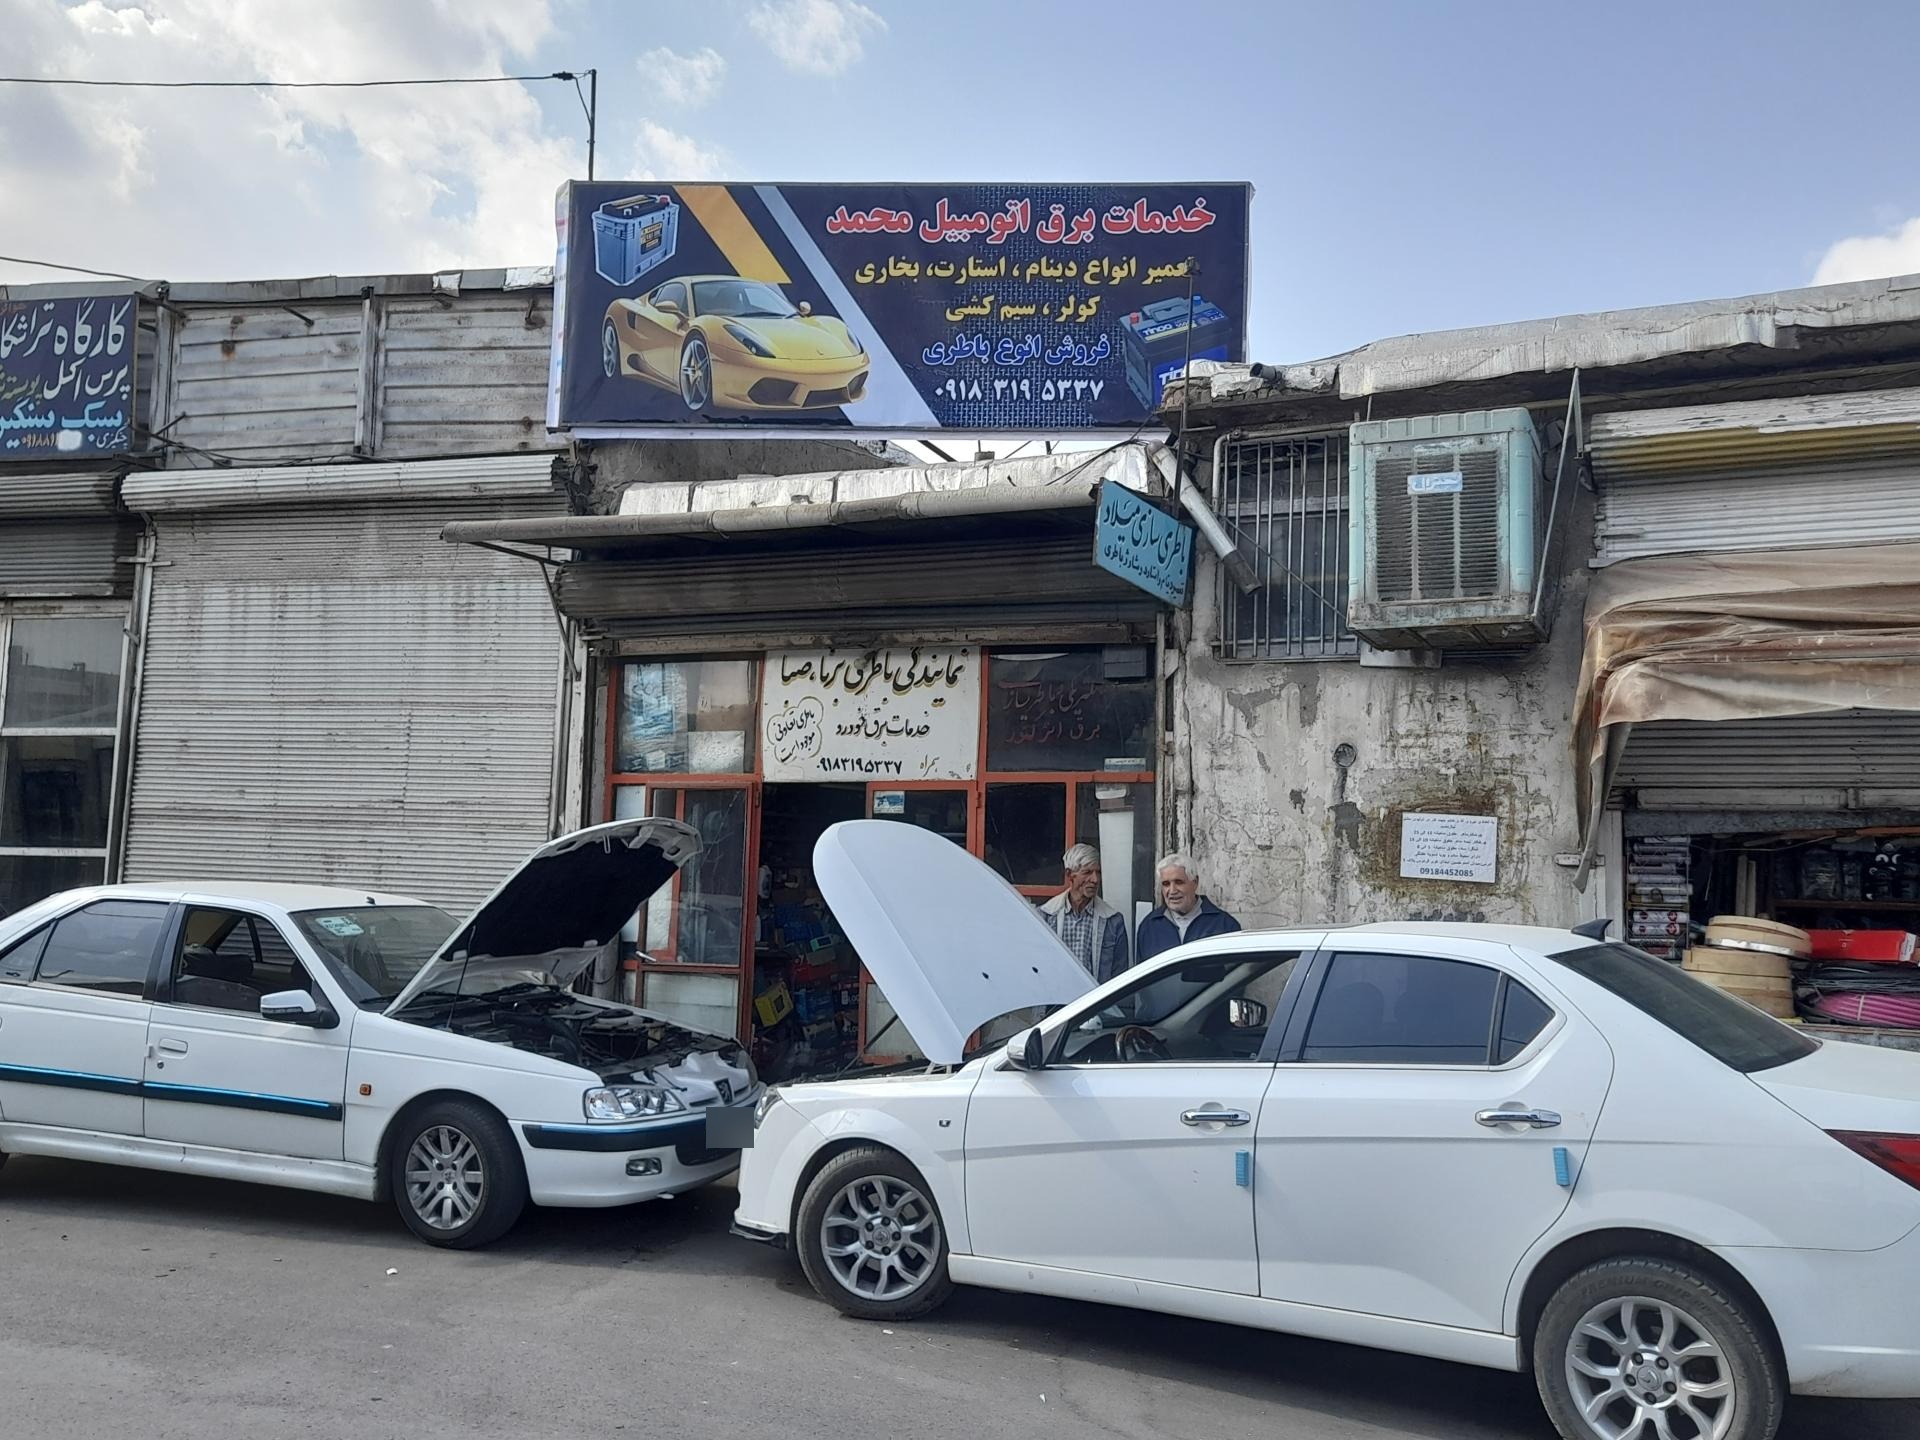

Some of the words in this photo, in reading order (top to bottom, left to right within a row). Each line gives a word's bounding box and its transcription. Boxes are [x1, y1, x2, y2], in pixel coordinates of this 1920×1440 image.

[826, 205, 914, 234] محمد
[918, 197, 1031, 244] اتومبیل
[1036, 203, 1096, 244] برق
[1102, 197, 1216, 234] خدمات
[855, 255, 920, 284] بخاری
[1025, 256, 1078, 284] دینام
[1084, 256, 1136, 285] انواع
[1141, 256, 1192, 285] عمیر
[945, 295, 995, 321] کشی
[1000, 302, 1036, 321] سیم
[1055, 295, 1101, 322] کولر
[0, 302, 55, 359] تراشکا
[54, 298, 131, 358] کارگاه
[922, 334, 991, 366] باطری
[993, 334, 1042, 366] انوع
[1045, 334, 1111, 366] فروش
[84, 364, 131, 400] پرس
[935, 379, 983, 401] ۰۹۱۸
[993, 379, 1031, 401] ۳۱۹
[1041, 379, 1104, 401] ۵۳۳۷
[61, 400, 123, 442] سبک
[1103, 499, 1141, 544] میلاد
[1131, 508, 1161, 548] سازی
[1157, 523, 1186, 576] باطری
[844, 649, 893, 704] باطری
[892, 648, 969, 707] نمایندگی
[835, 707, 866, 738] خودرو
[864, 707, 888, 746] برق
[885, 710, 930, 738] خدمات
[816, 756, 902, 775] ۰۹۱۸۳۱۹۵۳۳۷
[1420, 867, 1474, 877] 09184452085
